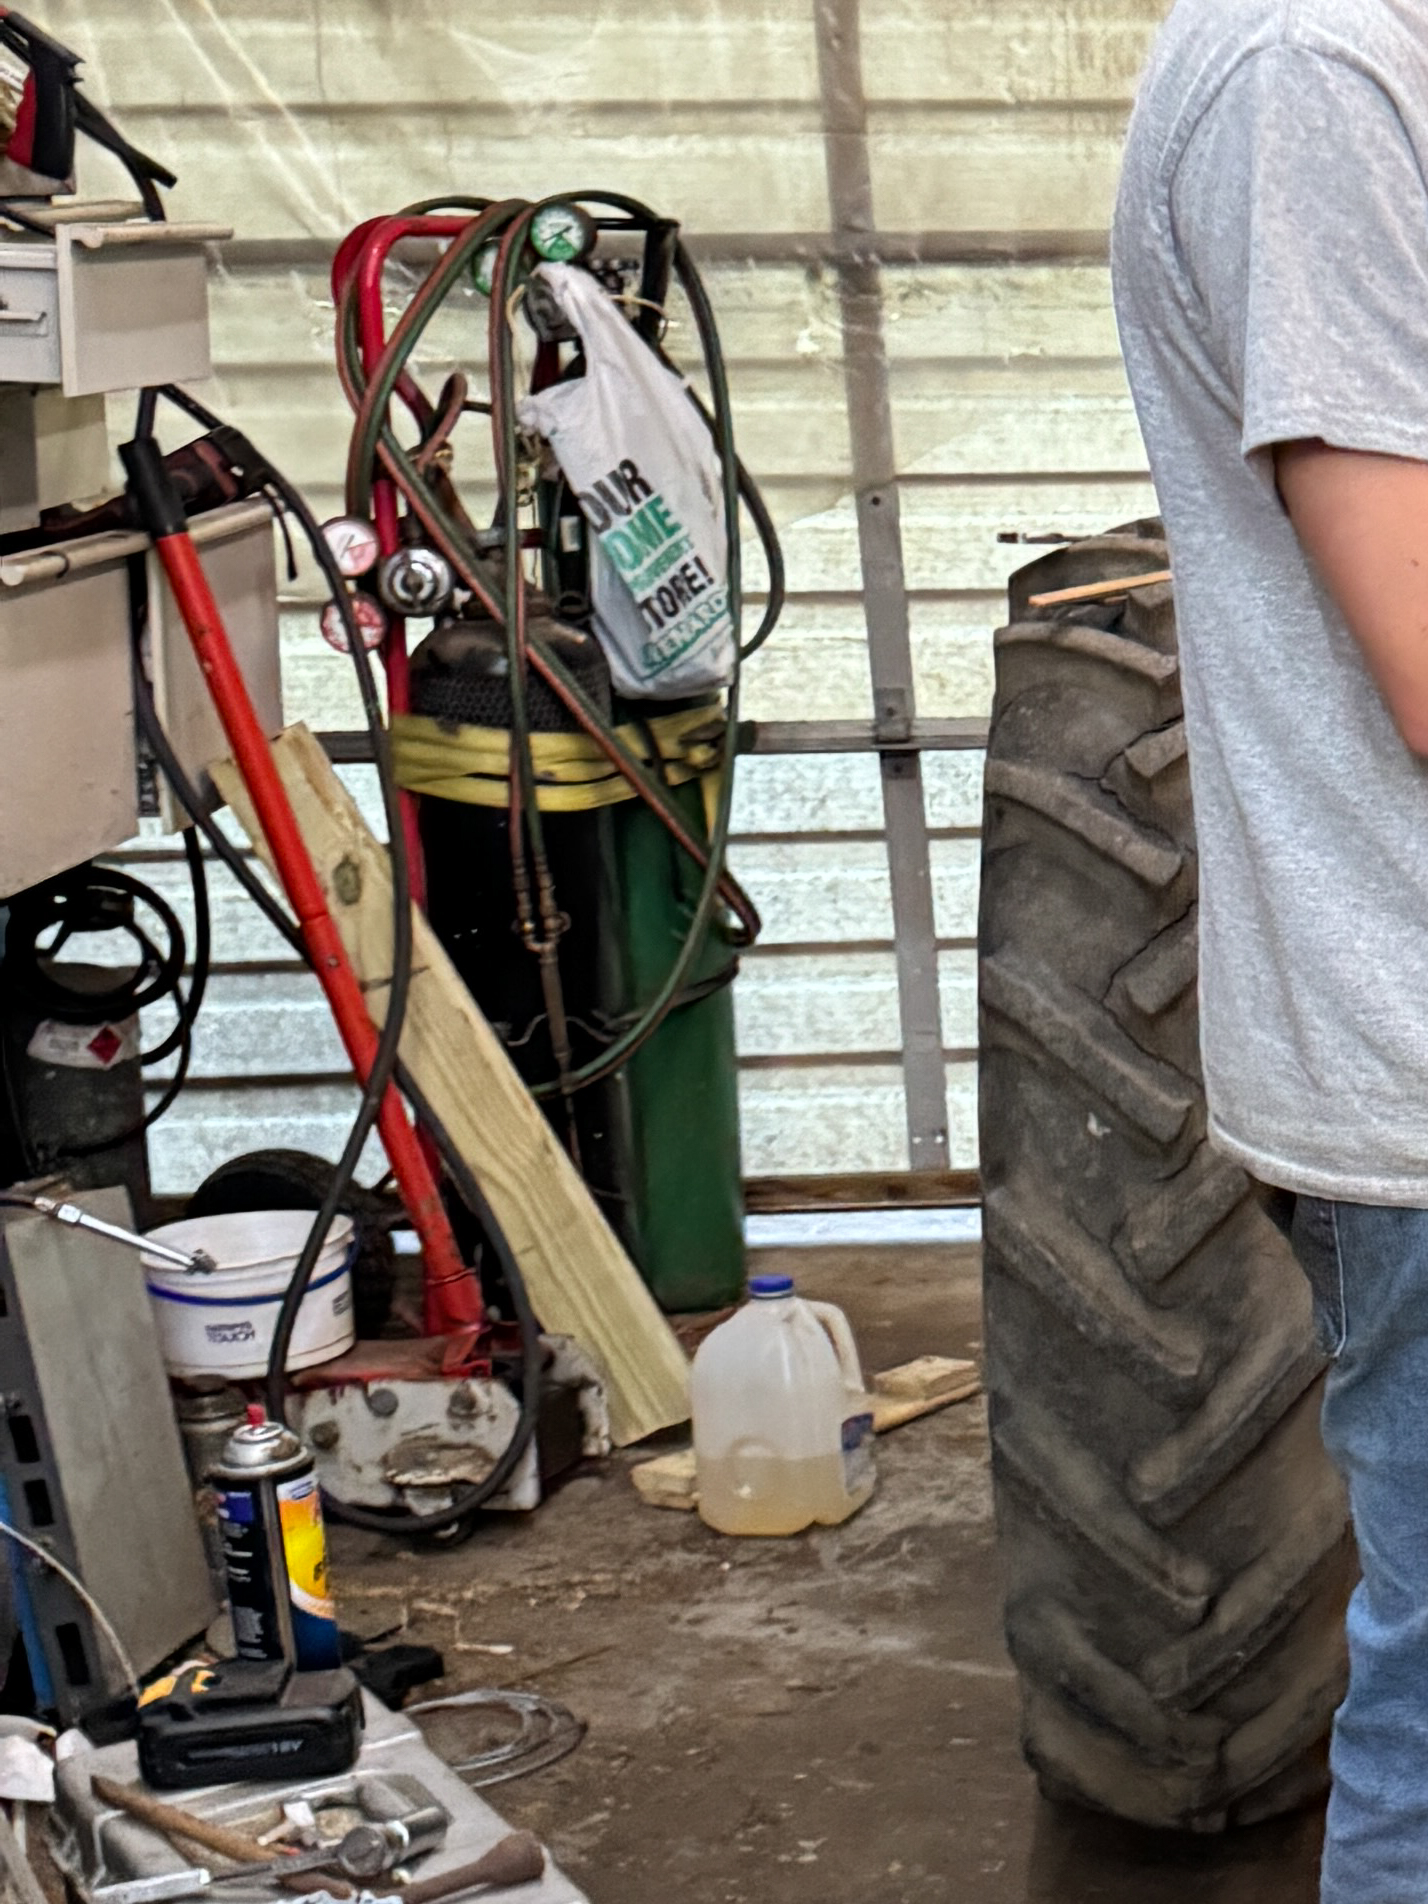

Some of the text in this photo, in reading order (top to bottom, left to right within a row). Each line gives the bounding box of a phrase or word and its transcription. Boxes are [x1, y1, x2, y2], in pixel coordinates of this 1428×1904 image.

[577, 458, 655, 534] OUR
[602, 495, 683, 573] OME
[639, 555, 715, 630] TORE!
